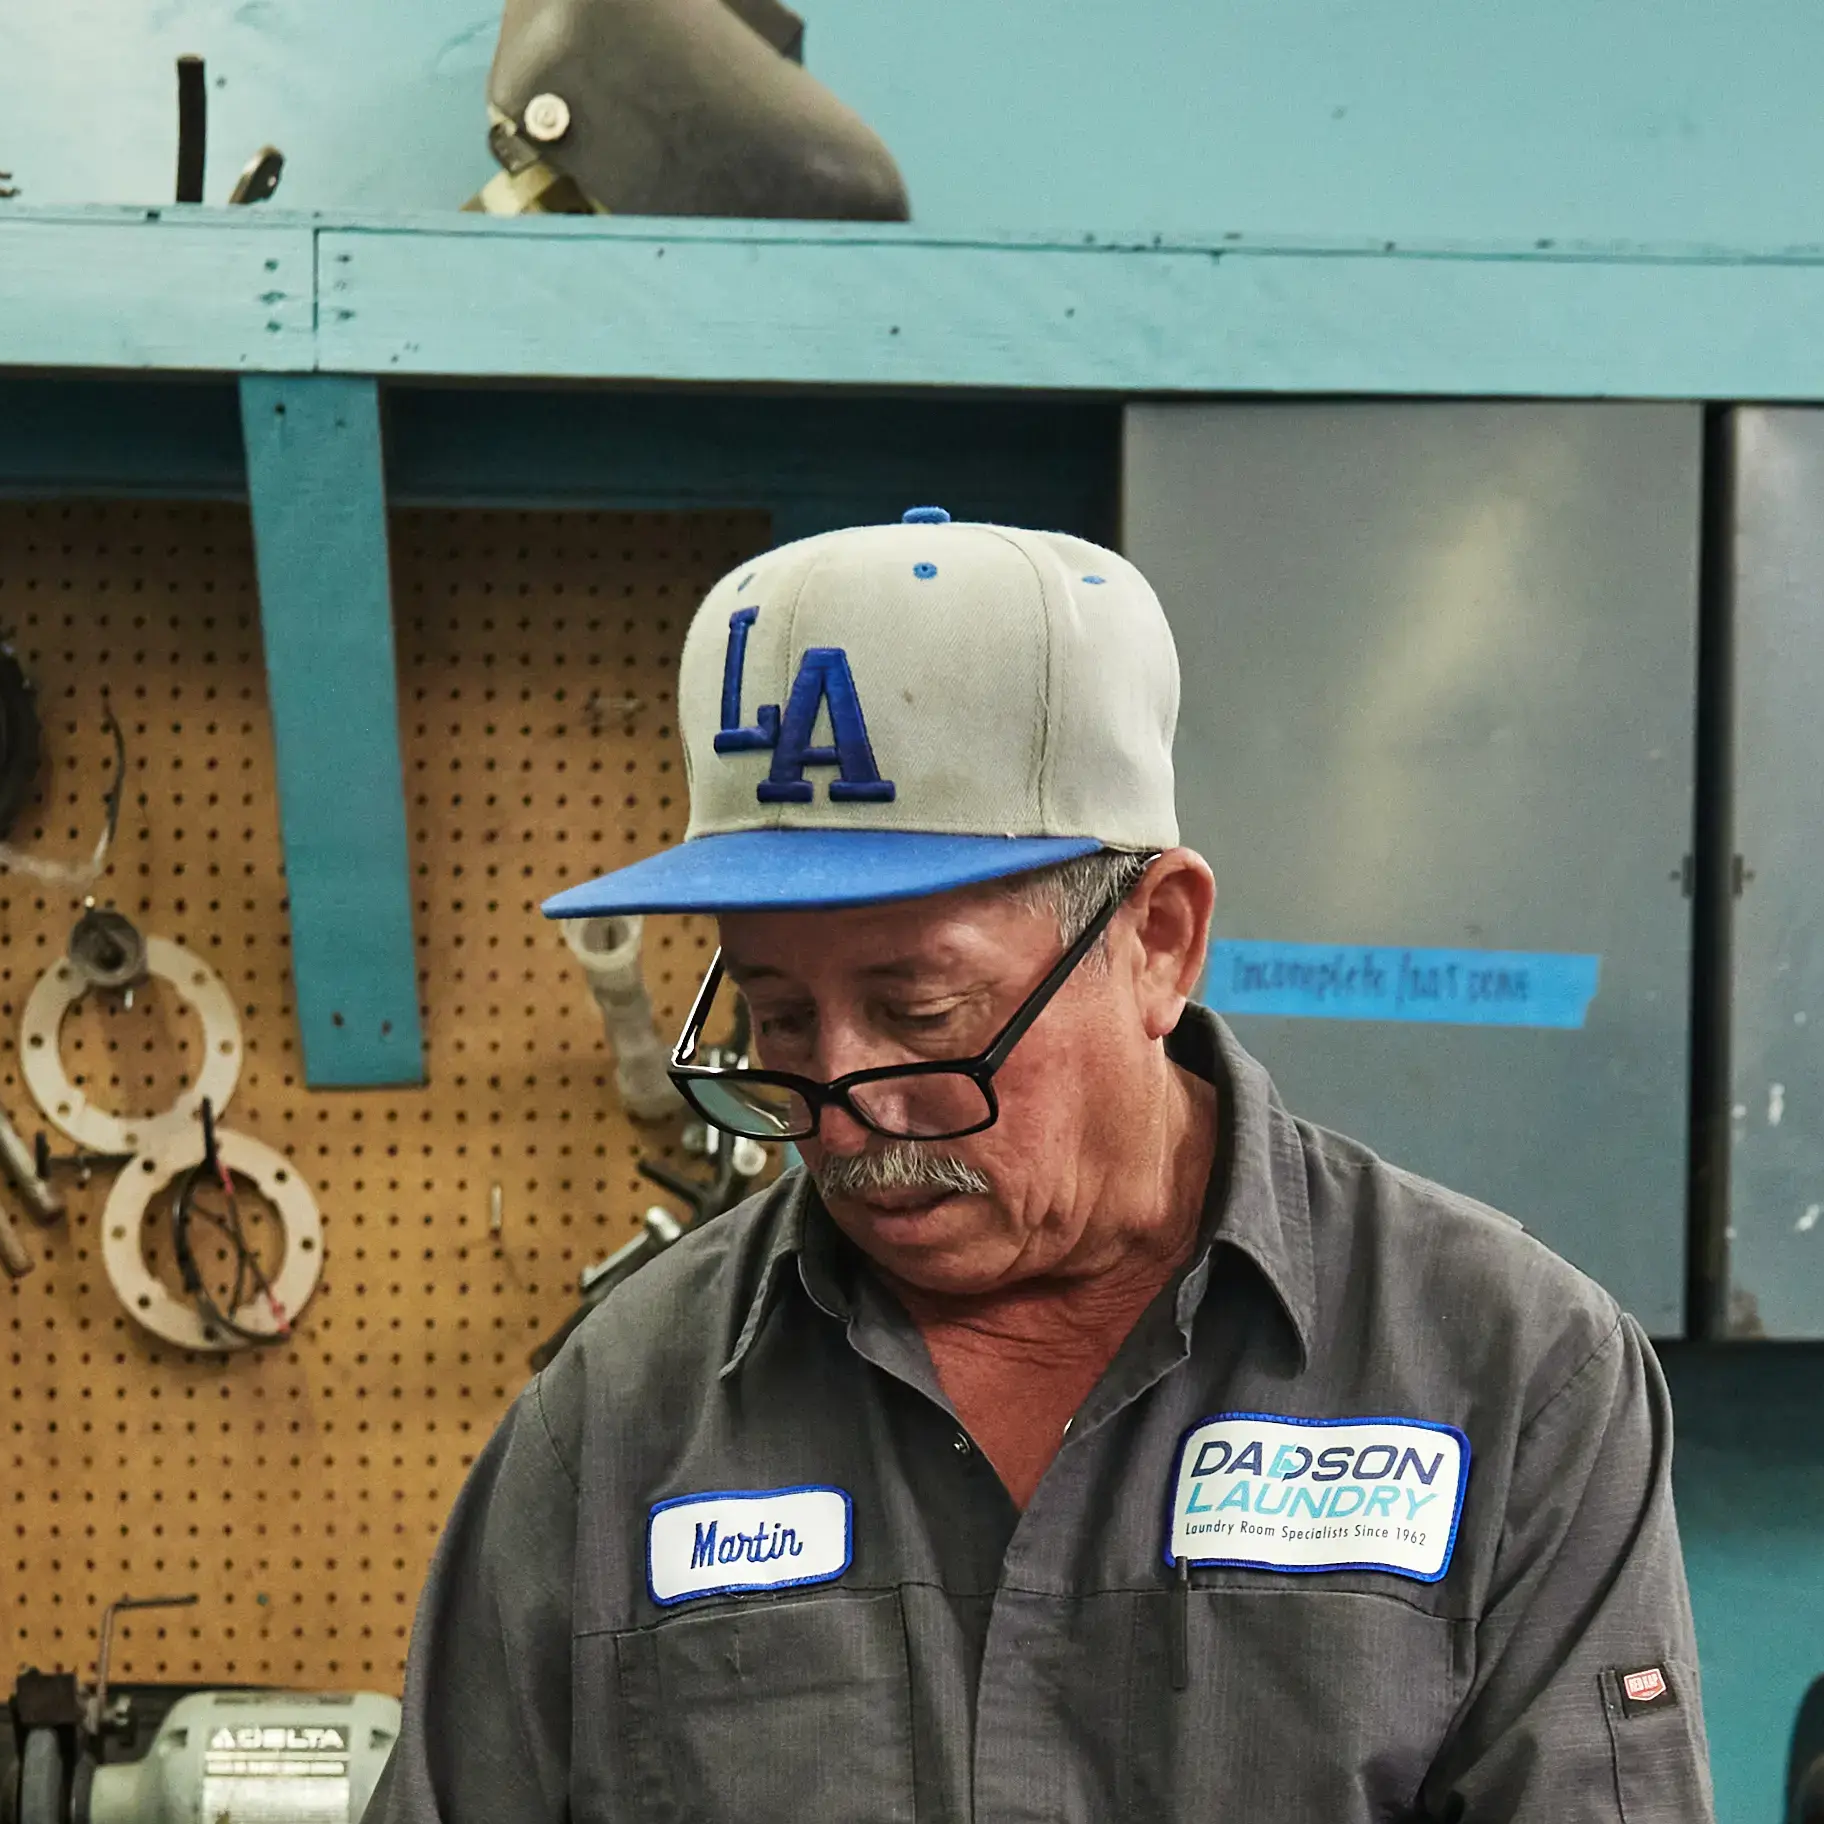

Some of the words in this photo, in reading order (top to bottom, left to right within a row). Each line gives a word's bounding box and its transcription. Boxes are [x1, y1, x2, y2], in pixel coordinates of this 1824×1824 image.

[714, 606, 896, 803] LA
[1190, 1440, 1445, 1485] DADSON
[1185, 1479, 1438, 1521] LAUNDRY
[690, 1520, 803, 1569] Martin
[1186, 1519, 1234, 1536] Laundry
[1240, 1521, 1275, 1537] Room
[1281, 1526, 1349, 1542] Specialists
[1354, 1525, 1389, 1538] Since
[1396, 1527, 1427, 1546] 1962
